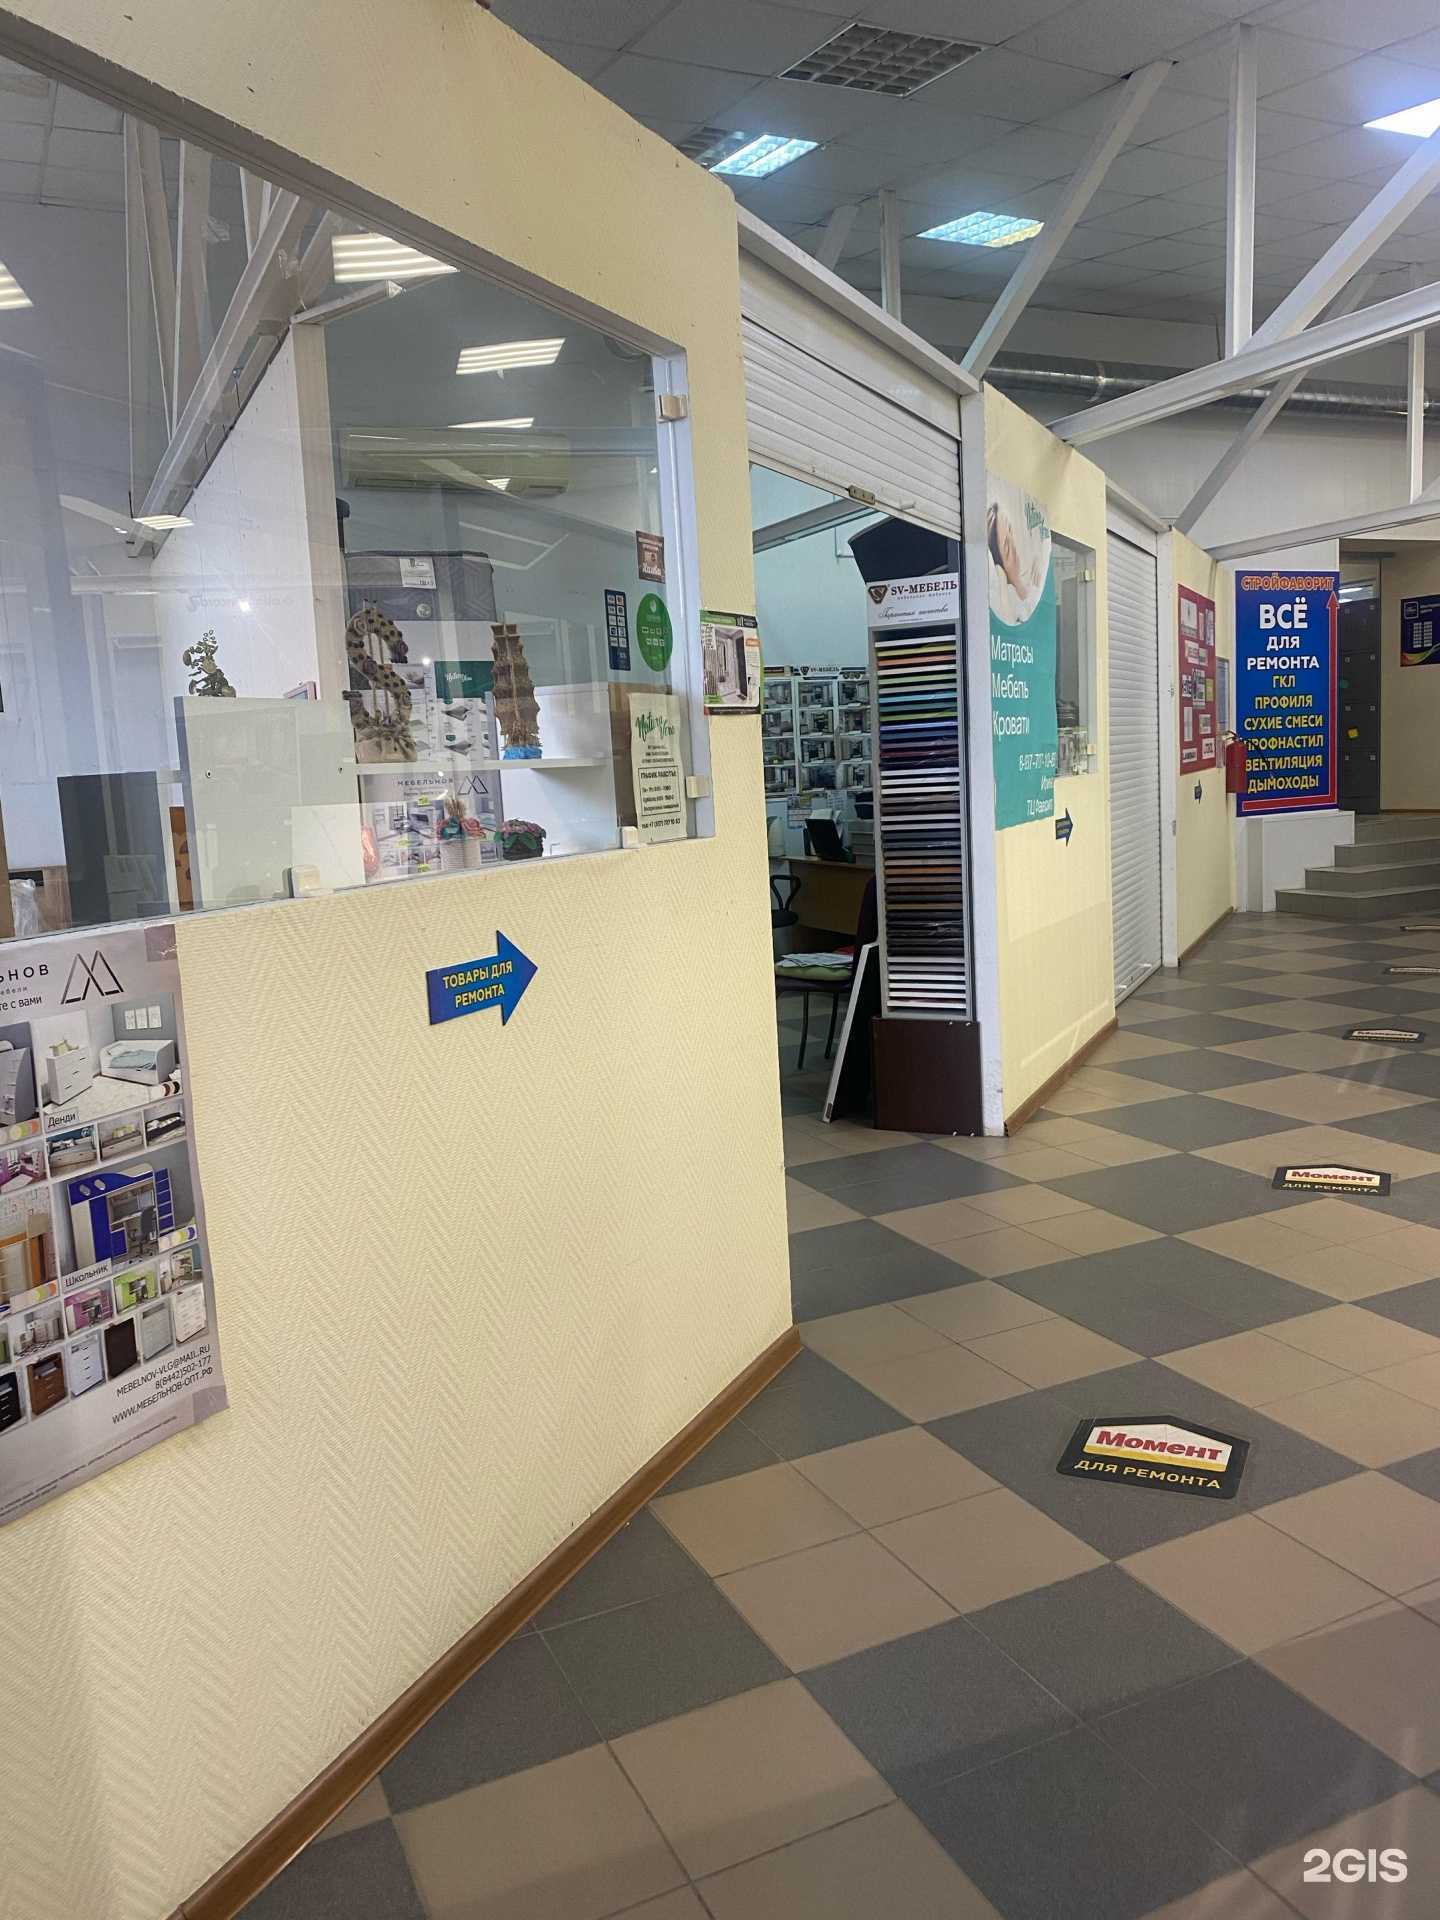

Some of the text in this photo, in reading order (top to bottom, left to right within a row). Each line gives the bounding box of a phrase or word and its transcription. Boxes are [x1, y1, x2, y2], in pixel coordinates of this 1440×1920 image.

[891, 580, 958, 596] SV-МЕБЕЛЬ
[1241, 572, 1335, 591] СТРОЙФАВОРИТ
[1260, 597, 1308, 629] ВСЁ
[991, 635, 1034, 669] Матрасы
[1267, 636, 1300, 651] ДЛЯ
[1247, 656, 1320, 670] РЕМОНТА
[992, 673, 1029, 700] Мебель
[1273, 675, 1295, 688] ГКЛ
[1255, 695, 1312, 709] ПРОФИЛЯ
[993, 710, 1029, 741] Кровати
[1244, 714, 1323, 731] СУХИЕ СМЕСИ
[1248, 775, 1319, 794] ДЫМОХОДЫ
[443, 961, 513, 989] ТОВАРЫ ДЛЯ
[455, 984, 505, 1008] РЕМОНТА
[48, 1113, 76, 1128] Денди
[1291, 1171, 1377, 1182] Момент
[1315, 1185, 1379, 1193] РЕМОНТА
[65, 1264, 108, 1287] Школьник
[116, 1344, 211, 1397] MEBELNOV-VLG@MAIL.RU
[155, 1355, 212, 1390] 8(8442)502-177
[112, 1367, 213, 1424] WWW.МЕБЕЛЬНОВ-ОПТ.РФ
[1096, 1430, 1222, 1461] Момент
[1074, 1460, 1221, 1489] ДЛЯ РЕМОНТА
